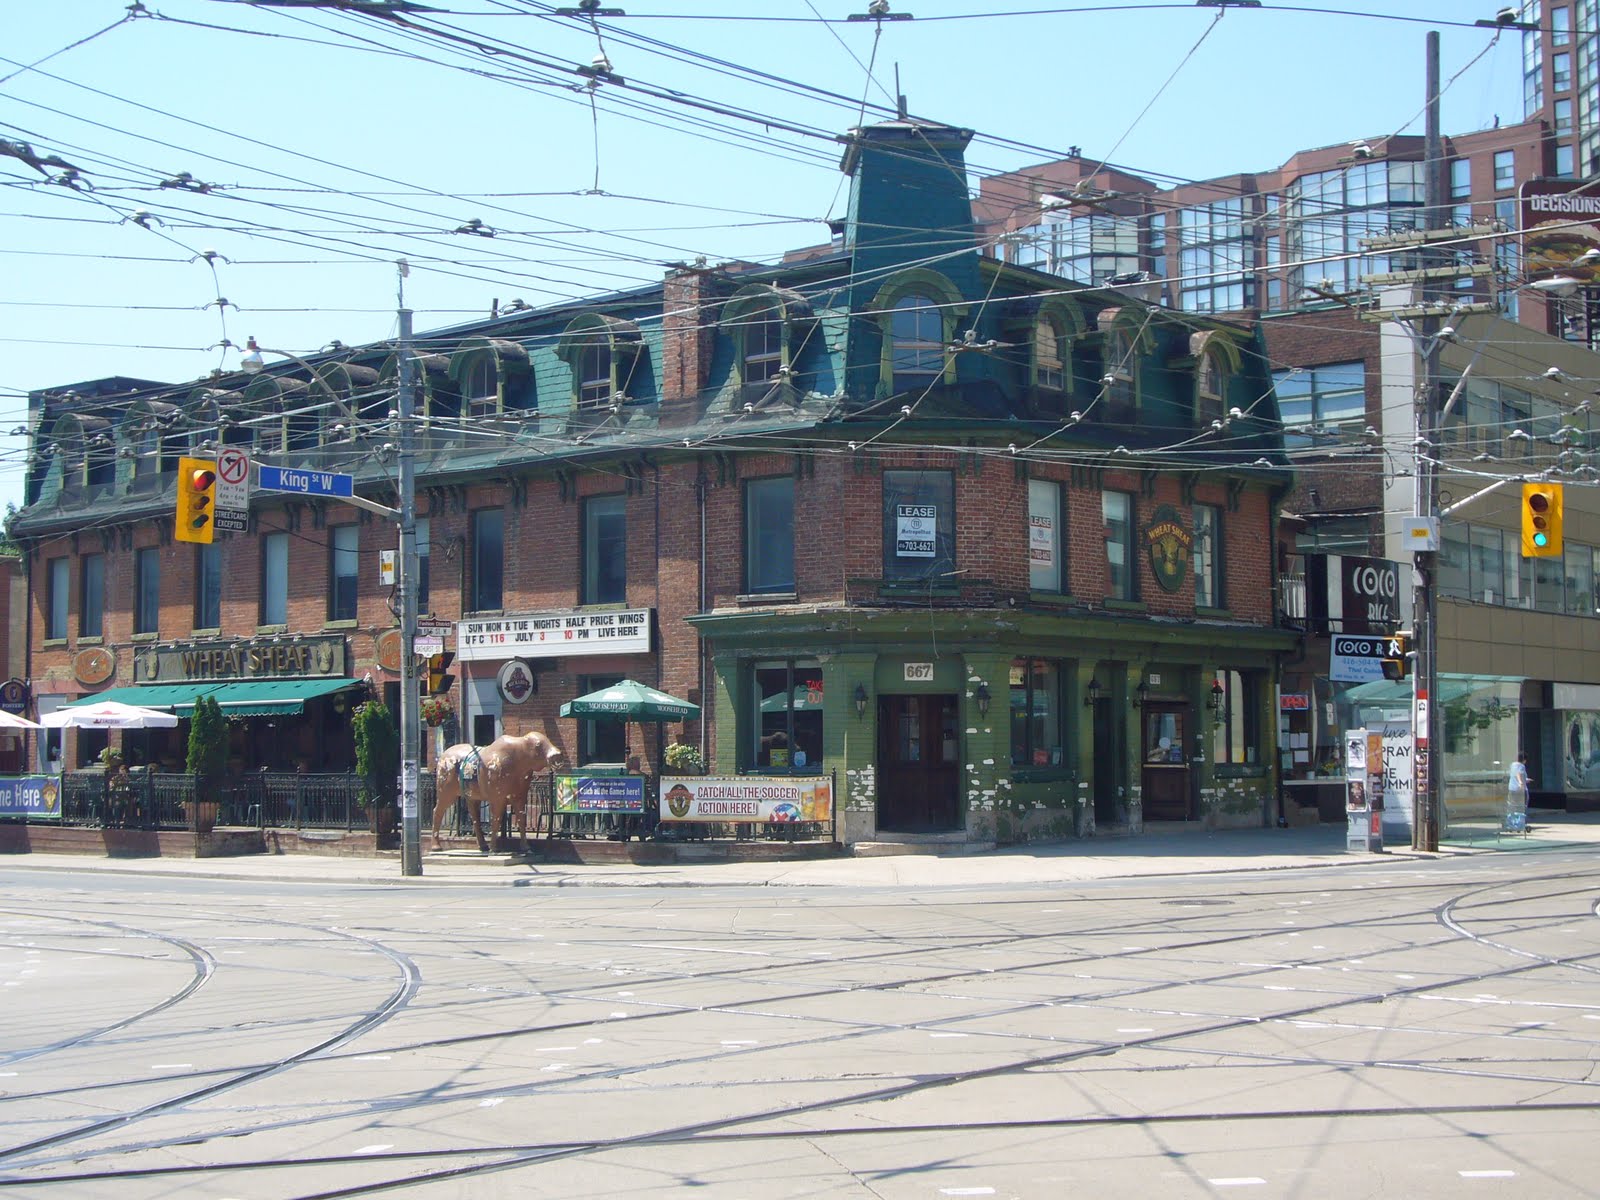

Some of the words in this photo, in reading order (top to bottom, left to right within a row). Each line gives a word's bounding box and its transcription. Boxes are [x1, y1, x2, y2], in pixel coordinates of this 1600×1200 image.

[280, 471, 309, 492] King
[312, 474, 320, 483] St
[321, 475, 333, 490] W
[215, 510, 247, 521] STREETCARS
[899, 507, 934, 517] LEASE
[217, 519, 244, 529] EXCEPTED
[1030, 516, 1051, 528] LEASE
[1148, 524, 1171, 539] WHEAT
[1171, 525, 1190, 545] SHEAF
[1353, 566, 1395, 597] COCO
[468, 623, 483, 633] SUN
[486, 622, 502, 632] MON
[505, 621, 511, 631] &
[513, 620, 528, 630] TUE
[533, 618, 561, 629] NIGHTS
[566, 617, 586, 628] HALF
[590, 615, 614, 626] PRICE
[618, 613, 645, 624] WINGS
[490, 633, 505, 643] 116
[515, 631, 534, 642] JULY
[540, 631, 546, 641] 3
[564, 630, 573, 640] 10
[578, 629, 590, 639] PM
[598, 627, 615, 638] LIVE
[617, 626, 638, 637] HERE
[1338, 641, 1371, 654] COCO
[181, 647, 244, 676] WHEAT
[249, 644, 310, 671] SHEAF
[906, 665, 931, 678] 667
[589, 702, 629, 710] MOOSEHEAD
[1281, 696, 1307, 707] OPEN
[657, 705, 688, 714] MOOSEHEAD
[1382, 746, 1411, 757] PRAY
[1382, 768, 1397, 779] HE
[15, 784, 40, 807] Here
[579, 787, 593, 795] Catch
[601, 787, 609, 795] the
[609, 787, 625, 796] Games
[626, 787, 640, 796] here!
[697, 786, 726, 799] CATCH
[727, 786, 741, 799] ALL
[743, 786, 760, 799] THE
[761, 786, 799, 799] SOCCER
[697, 802, 729, 814] ACTION
[730, 802, 757, 814] HERE!
